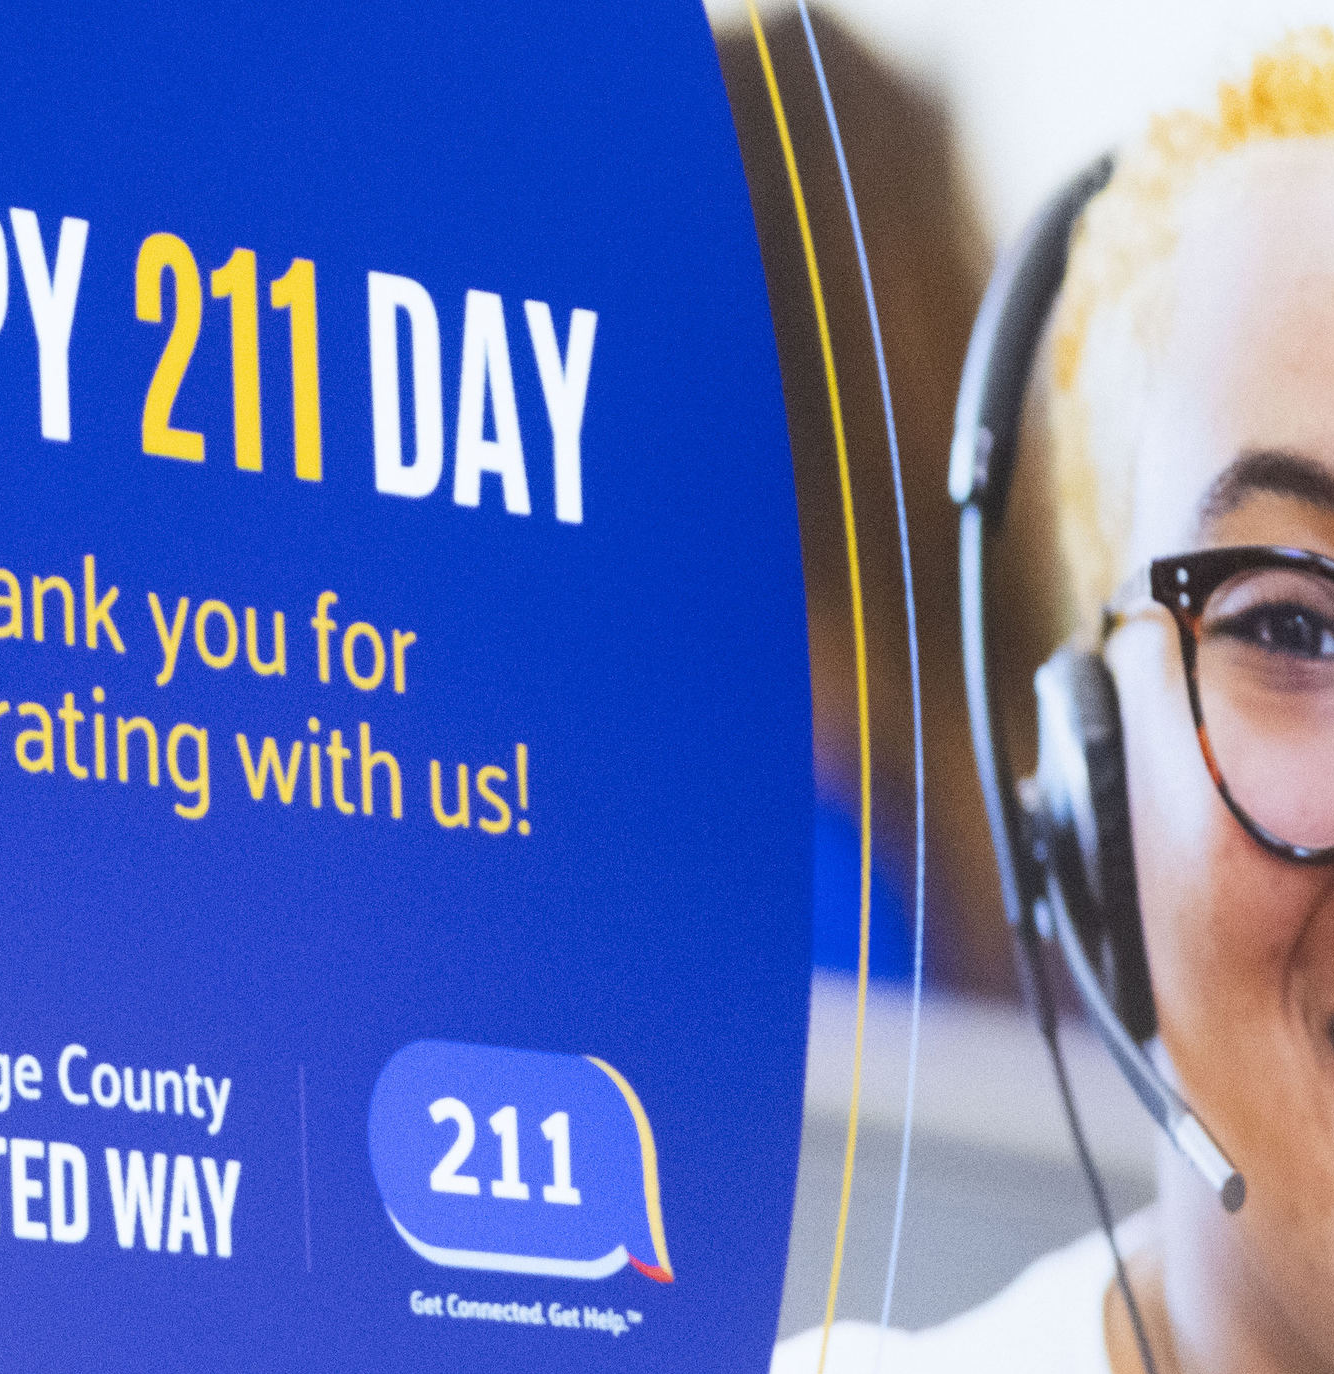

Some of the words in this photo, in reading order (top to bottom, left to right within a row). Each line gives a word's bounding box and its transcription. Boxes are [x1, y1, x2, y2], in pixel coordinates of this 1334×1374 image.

[134, 232, 324, 482] 211
[367, 270, 598, 525] DAY
[147, 592, 287, 687] you
[310, 590, 417, 694] for
[235, 716, 403, 820] with
[429, 743, 531, 836] us!
[57, 1043, 232, 1135] County
[104, 1147, 242, 1258] WAY
[427, 1096, 582, 1206] 211
[409, 1290, 444, 1317] Get
[446, 1293, 546, 1325] Connected.
[547, 1302, 581, 1328] Get
